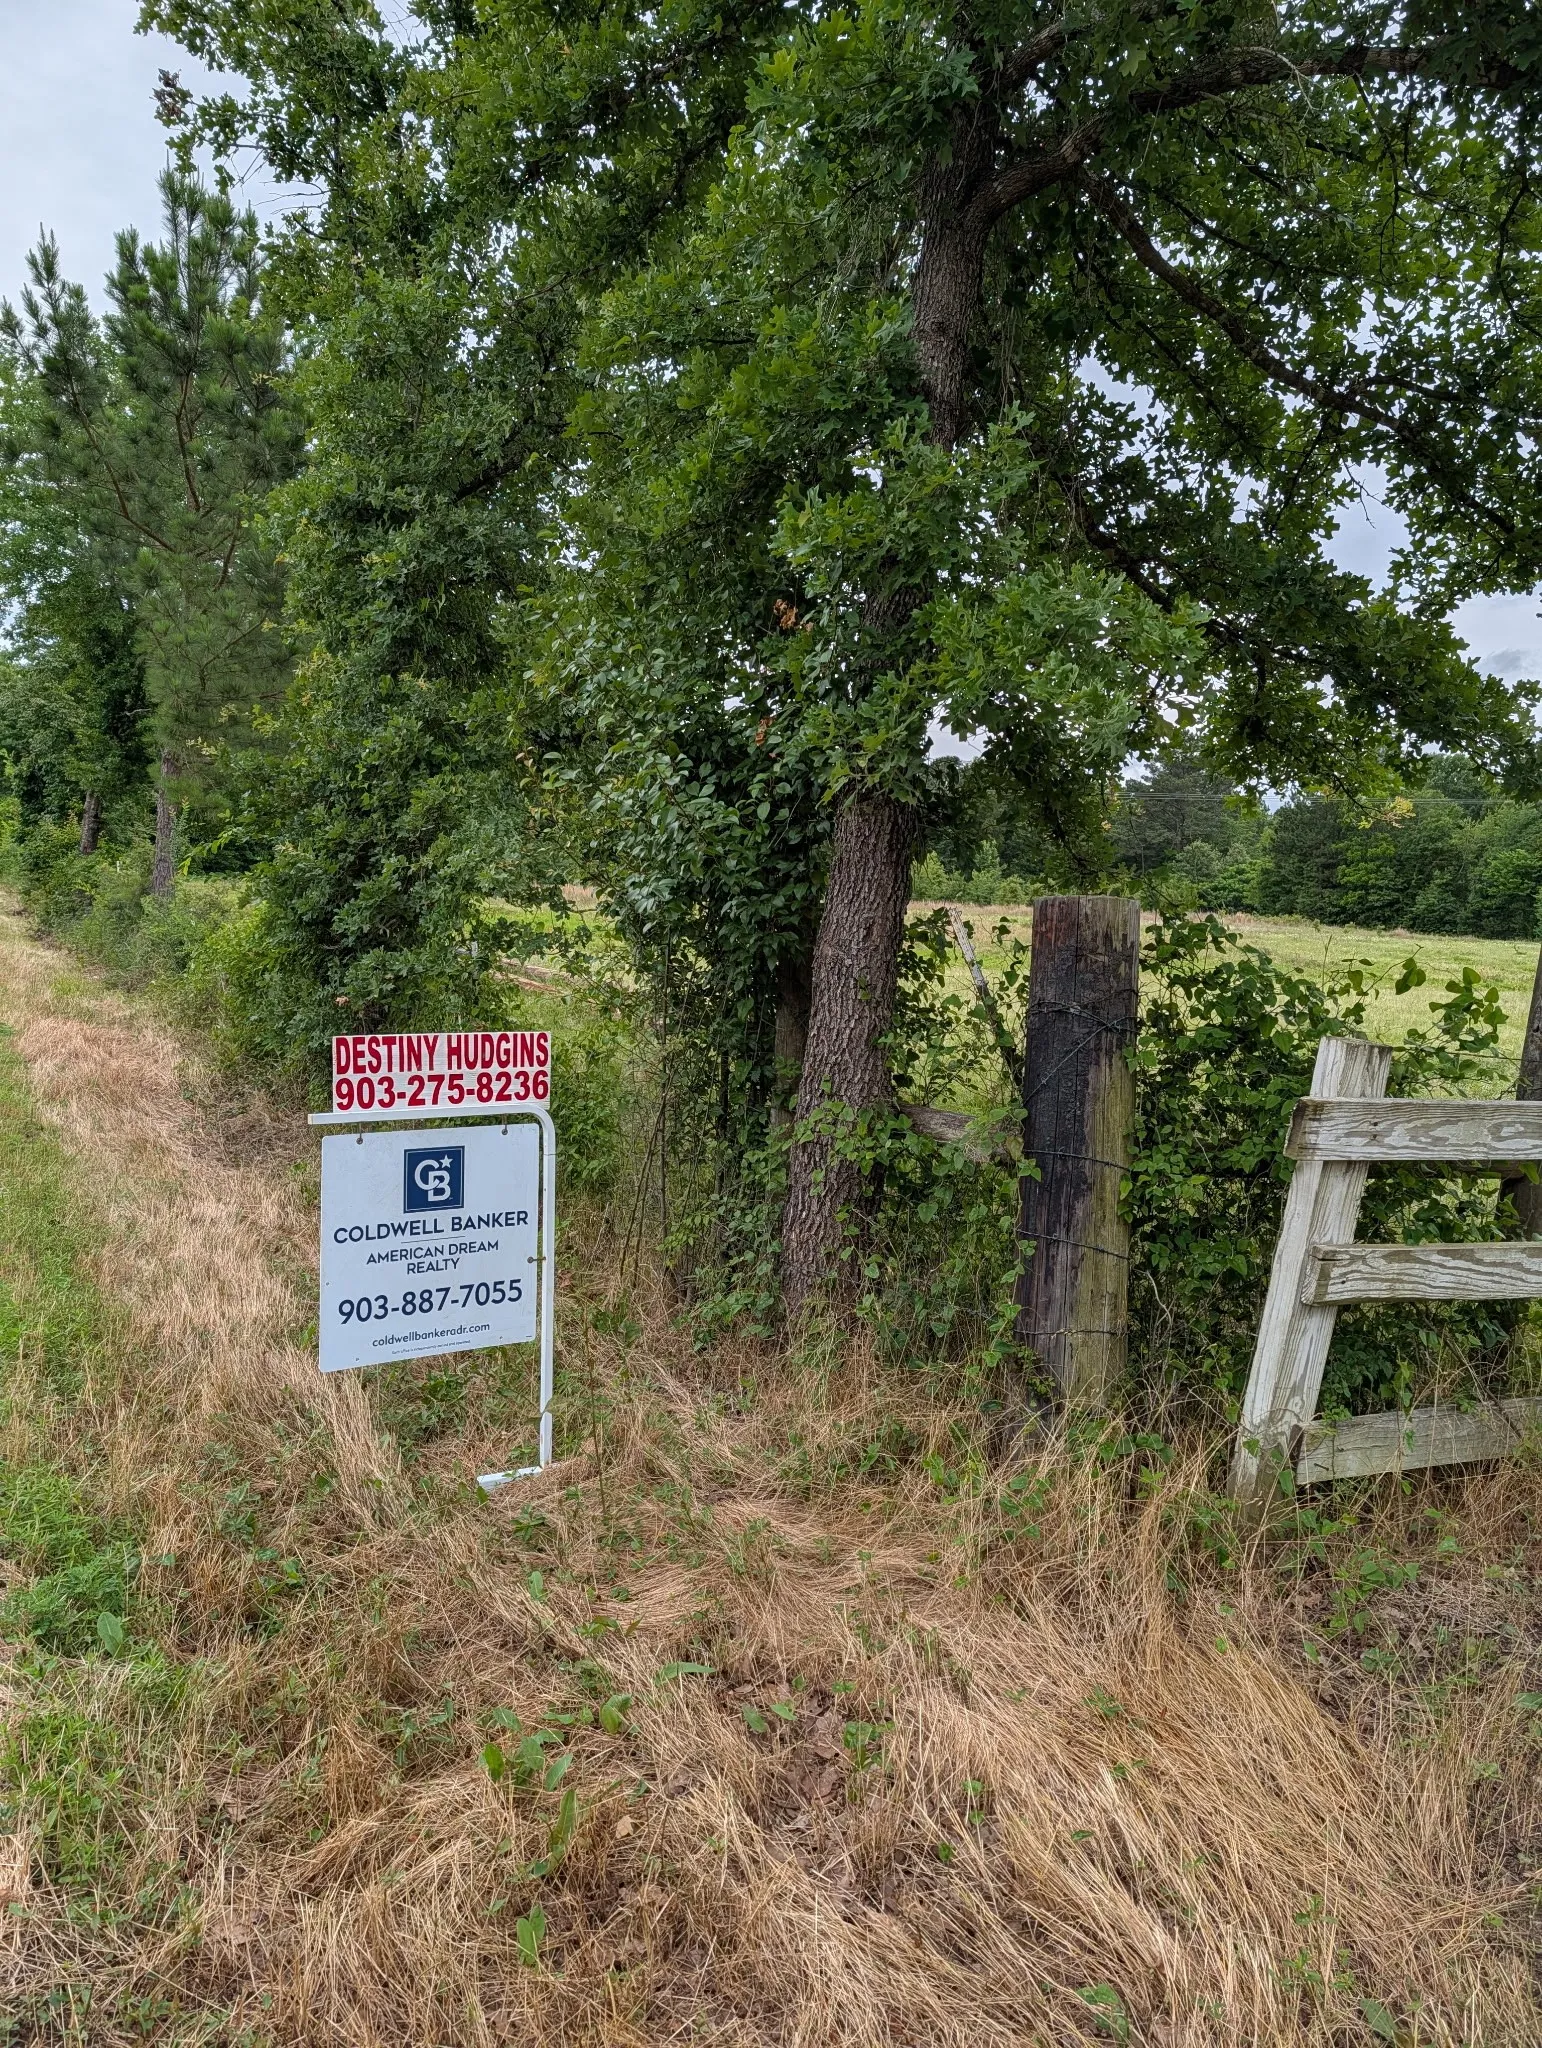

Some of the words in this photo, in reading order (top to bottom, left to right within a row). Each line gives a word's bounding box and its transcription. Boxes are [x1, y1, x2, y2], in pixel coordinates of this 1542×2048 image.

[335, 1035, 439, 1075] DESTINY
[447, 1032, 548, 1070] HUDGINS
[335, 1070, 548, 1111] 903-275-8236
[334, 1218, 444, 1243] COLDWELL
[451, 1211, 528, 1232] BANKER
[366, 1245, 445, 1265] AMERICAN
[449, 1240, 499, 1255] DREAM
[407, 1258, 460, 1274] REALTY
[338, 1279, 523, 1324] 903-887-7055
[372, 1322, 490, 1347] coldwellbankeradr.com
